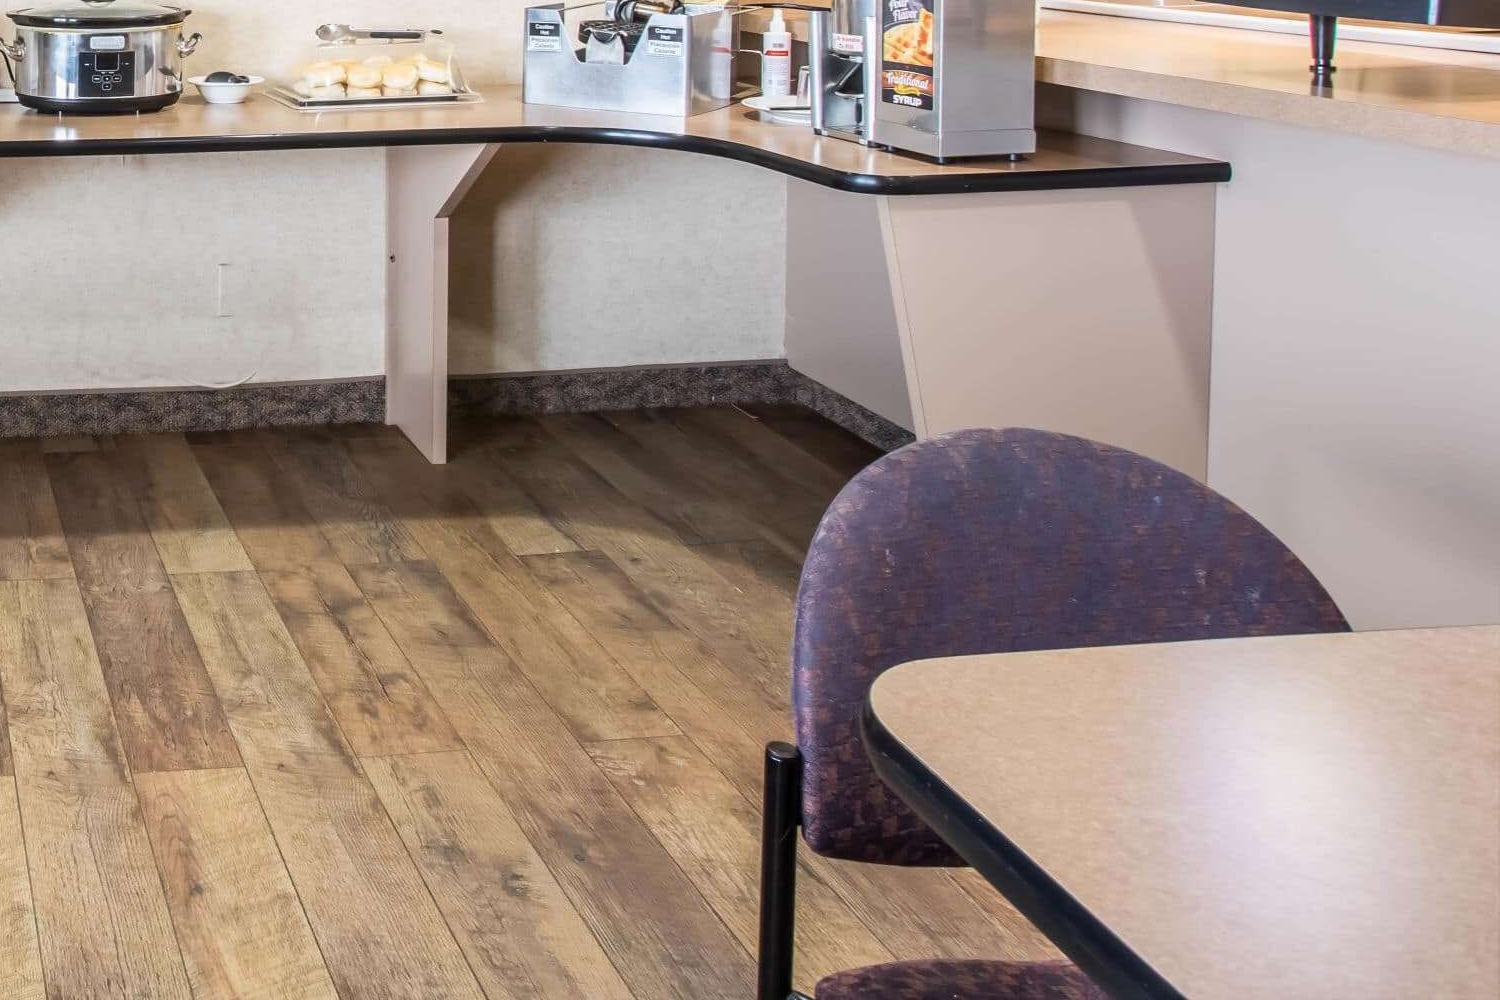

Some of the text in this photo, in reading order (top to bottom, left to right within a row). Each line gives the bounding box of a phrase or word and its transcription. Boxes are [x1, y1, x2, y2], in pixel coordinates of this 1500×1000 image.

[893, 9, 918, 22] Flavor
[887, 72, 929, 90] Traditional
[893, 94, 922, 107] SYRUP
